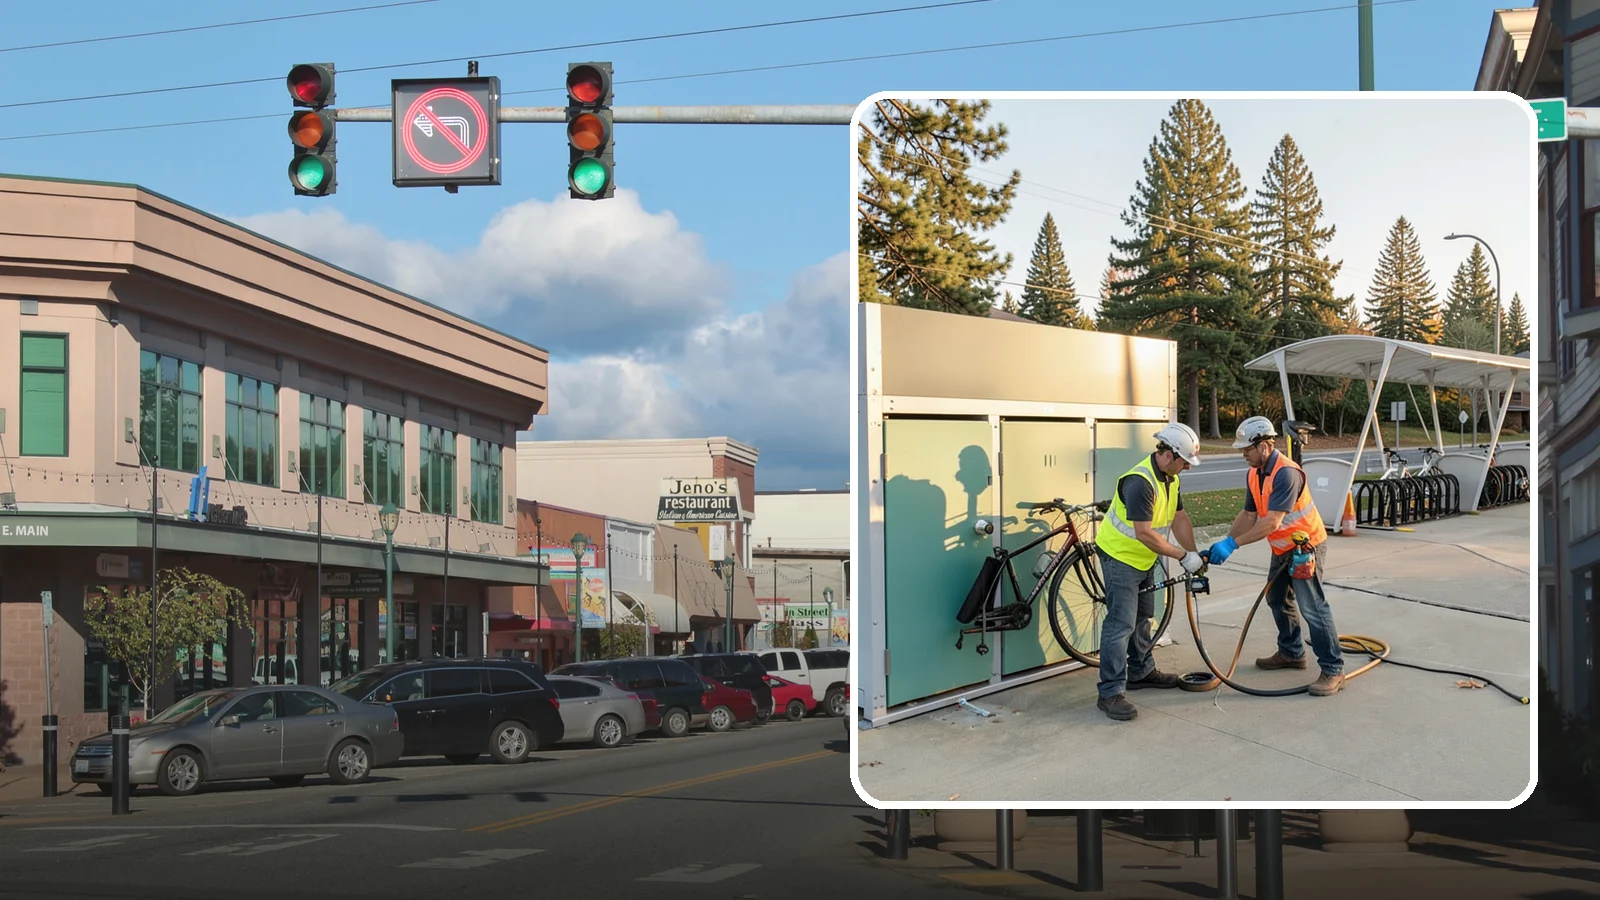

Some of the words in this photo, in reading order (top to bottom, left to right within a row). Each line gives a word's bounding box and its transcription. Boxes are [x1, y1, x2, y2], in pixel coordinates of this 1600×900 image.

[669, 479, 728, 495] Jeno's
[665, 496, 731, 509] restaurant
[686, 509, 714, 519] American
[715, 509, 738, 519] Cuisine
[2, 525, 13, 536] E.
[15, 525, 49, 536] MAIN
[797, 607, 828, 617] Street
